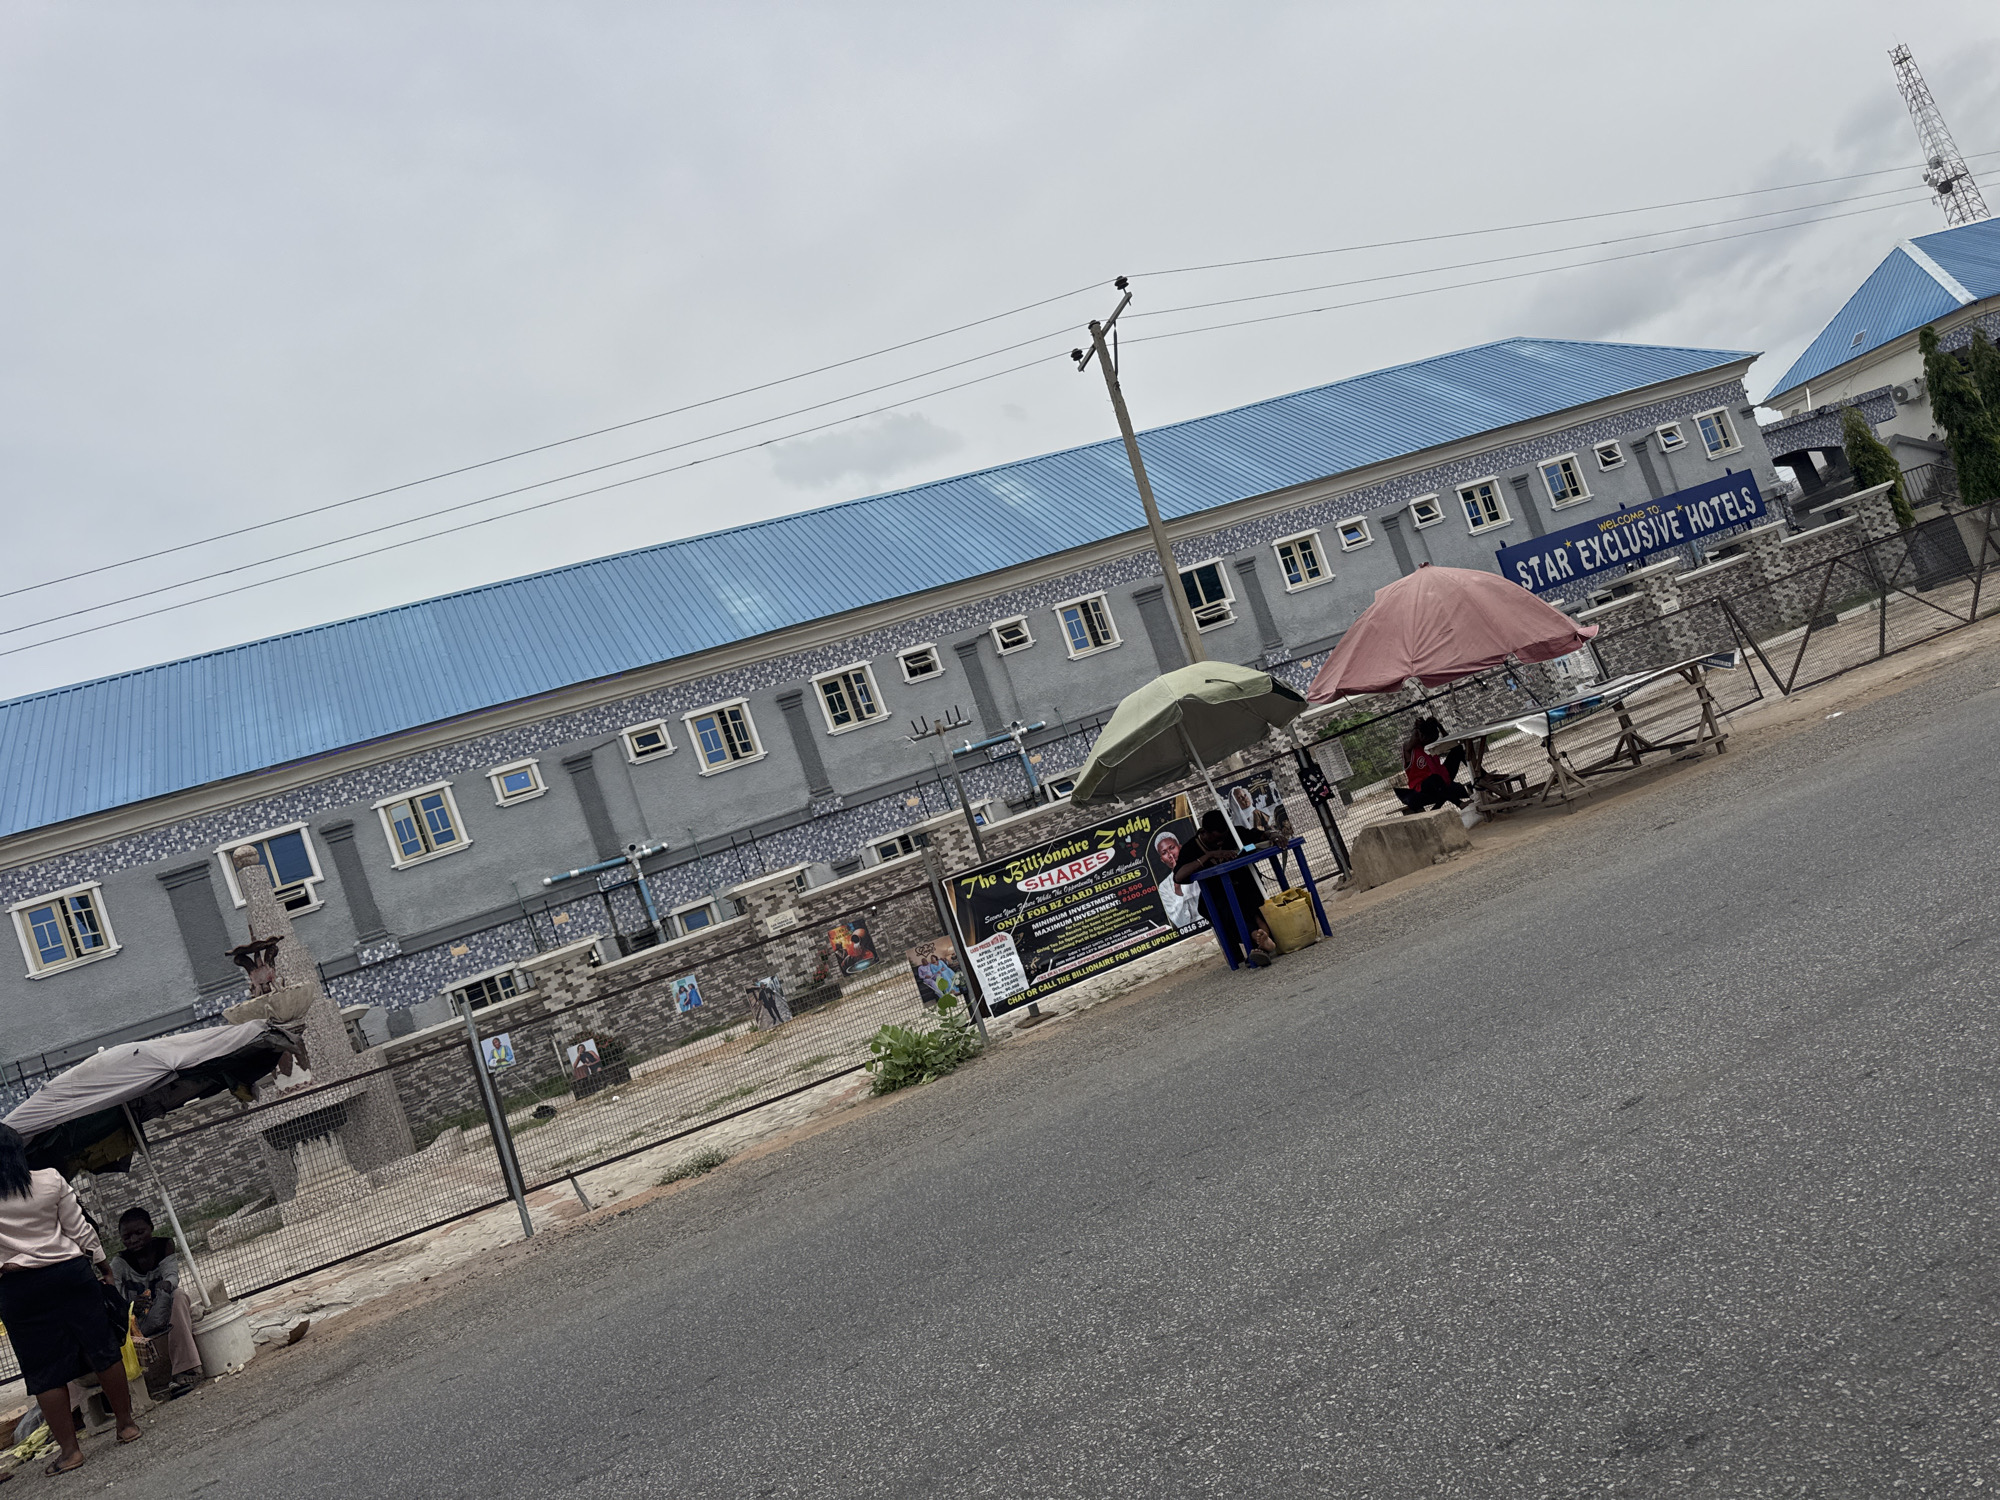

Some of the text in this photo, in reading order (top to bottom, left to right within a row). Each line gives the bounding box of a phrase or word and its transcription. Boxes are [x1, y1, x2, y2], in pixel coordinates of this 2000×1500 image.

[1646, 504, 1662, 520] TO:
[1516, 486, 1757, 590] STAR EXCLUSIVE HOTELS
[961, 816, 1150, 899] The Billionaire Zaddy
[1024, 852, 1109, 891] SHARES
[997, 869, 1141, 930] ONLY FOR BZ CARD HOLDERS
[1002, 907, 1017, 917] Your
[1051, 888, 1062, 897] The
[1063, 878, 1094, 893] Opportunity
[1101, 868, 1114, 878] Still
[1032, 911, 1067, 929] MINIMUM
[1068, 893, 1116, 915] INVESTMENT:
[1034, 918, 1072, 937] MAXIMUM
[1073, 899, 1121, 921] INVESTMENT:
[1007, 992, 1026, 1005] CHAT
[1026, 987, 1038, 997] OR
[1038, 980, 1057, 992] CALL
[1056, 974, 1071, 984] THE
[1071, 956, 1115, 979] BILLIONAIRE
[1114, 950, 1130, 961] FOR
[1130, 942, 1151, 955] MORE
[1151, 931, 1179, 946] UPDATE:
[1179, 923, 1197, 935] 0816
